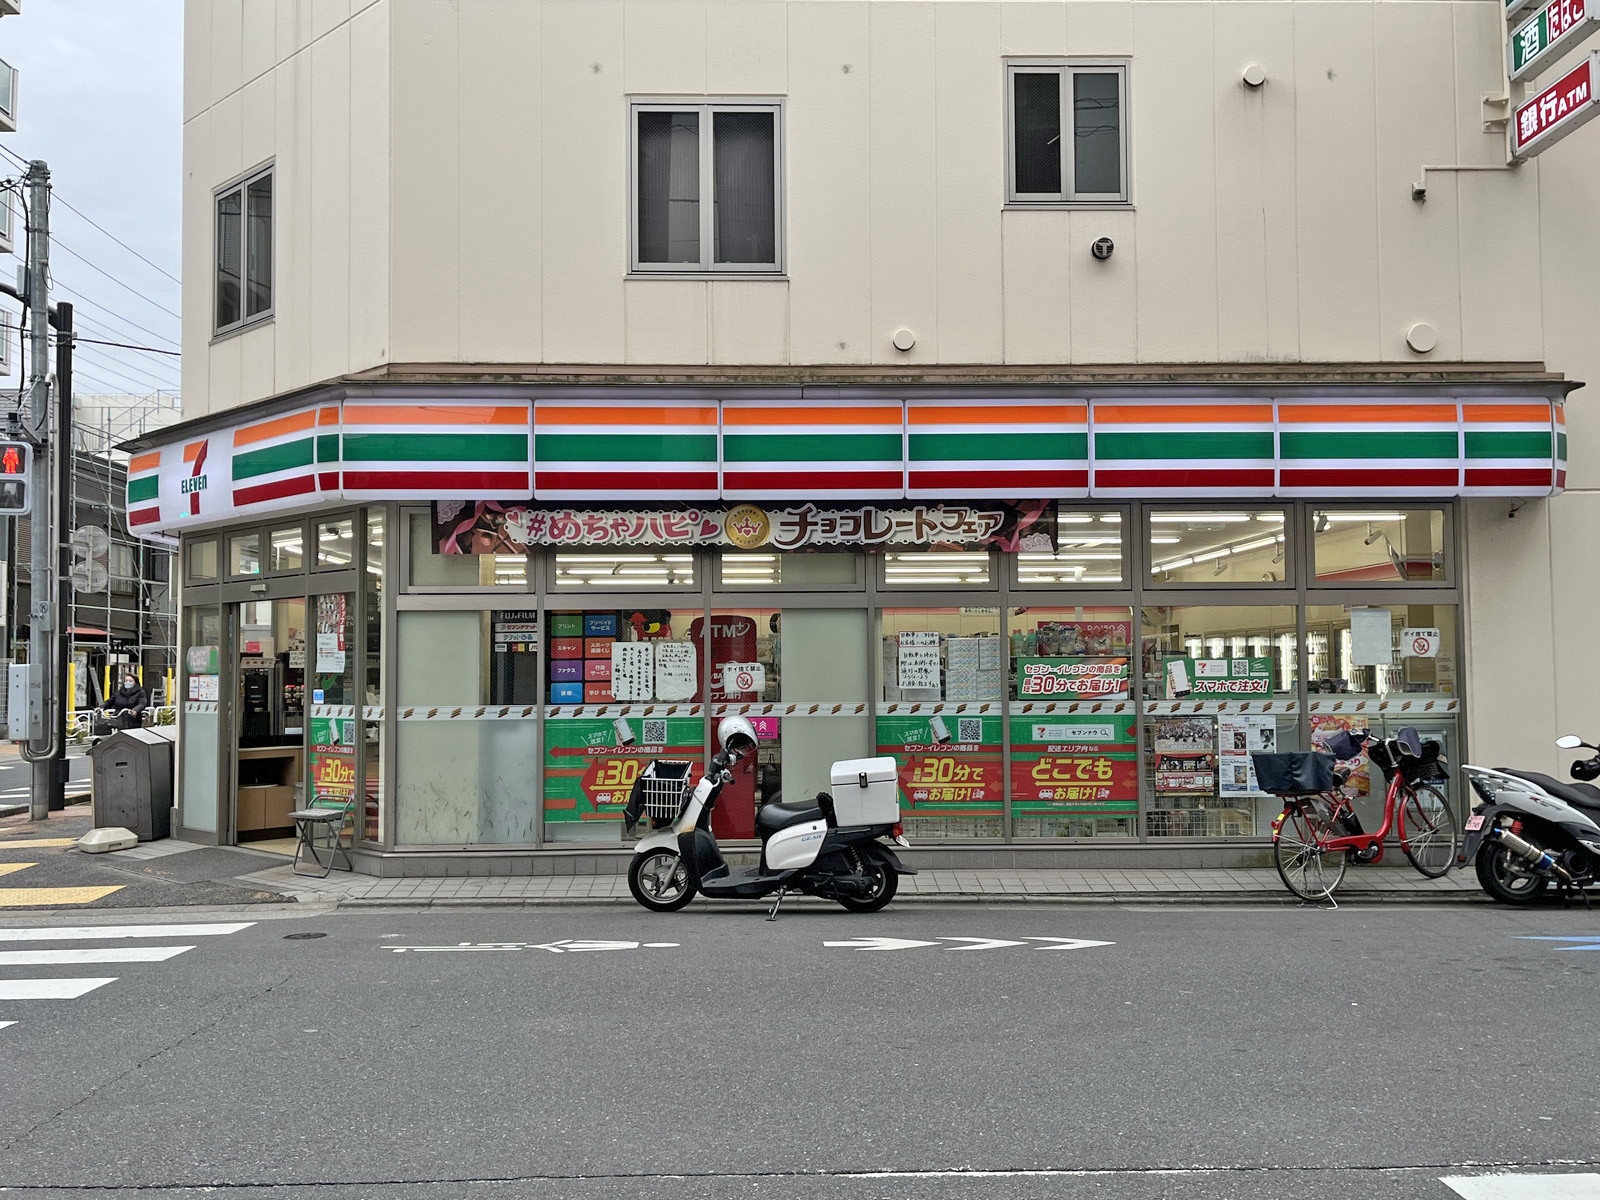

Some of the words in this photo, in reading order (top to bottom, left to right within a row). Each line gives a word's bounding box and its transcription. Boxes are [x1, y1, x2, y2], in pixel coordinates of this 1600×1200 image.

[1520, 18, 1539, 65] 酒
[526, 509, 700, 541] #めちゃハピ
[775, 503, 1003, 548] チョコレートフェア
[1195, 680, 1269, 693] スマホで注文!
[1031, 757, 1113, 780] どこでも
[929, 788, 972, 801] お届け!
[1053, 787, 1097, 800] お届け!
[801, 834, 822, 842] GEAR
